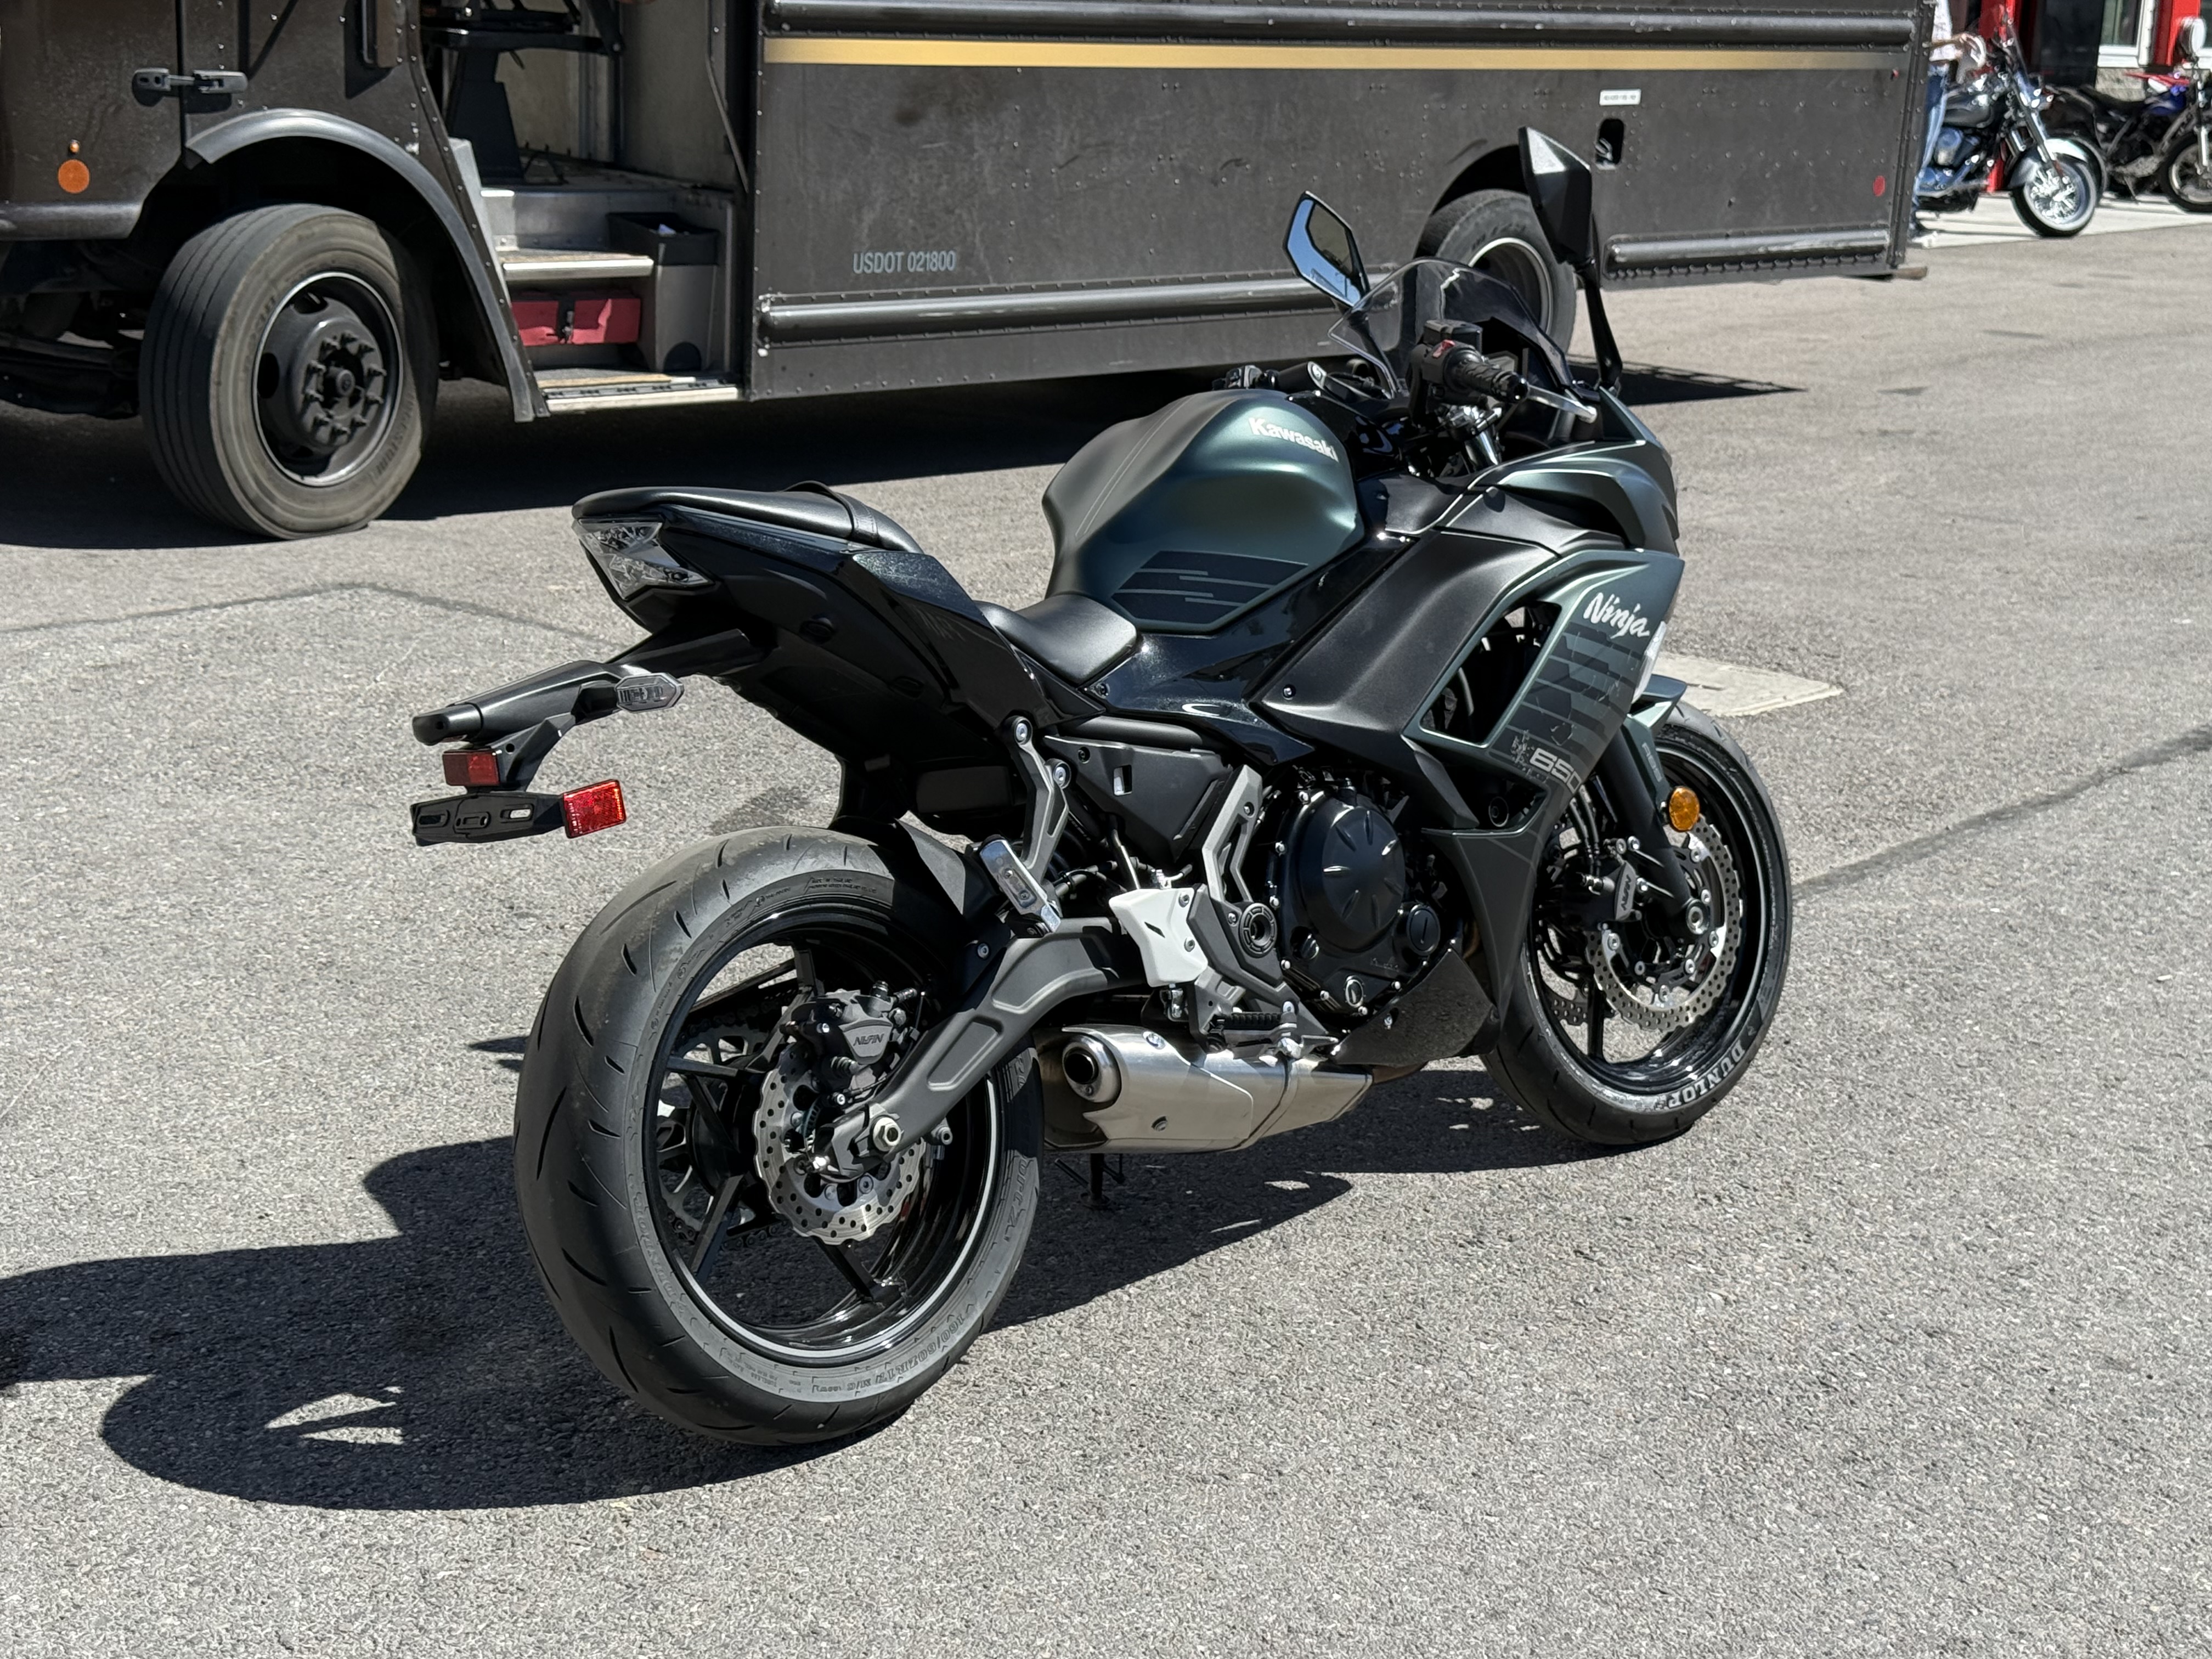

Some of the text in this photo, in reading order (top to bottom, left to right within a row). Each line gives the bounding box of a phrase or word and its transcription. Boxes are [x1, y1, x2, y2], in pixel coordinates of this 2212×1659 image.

[853, 250, 956, 274] USDOT 021800
[1249, 417, 1339, 463] Kawasaki
[1583, 592, 1650, 639] Ninja
[1530, 748, 1582, 794] 650
[1668, 1040, 1746, 1108] DUNLOP
